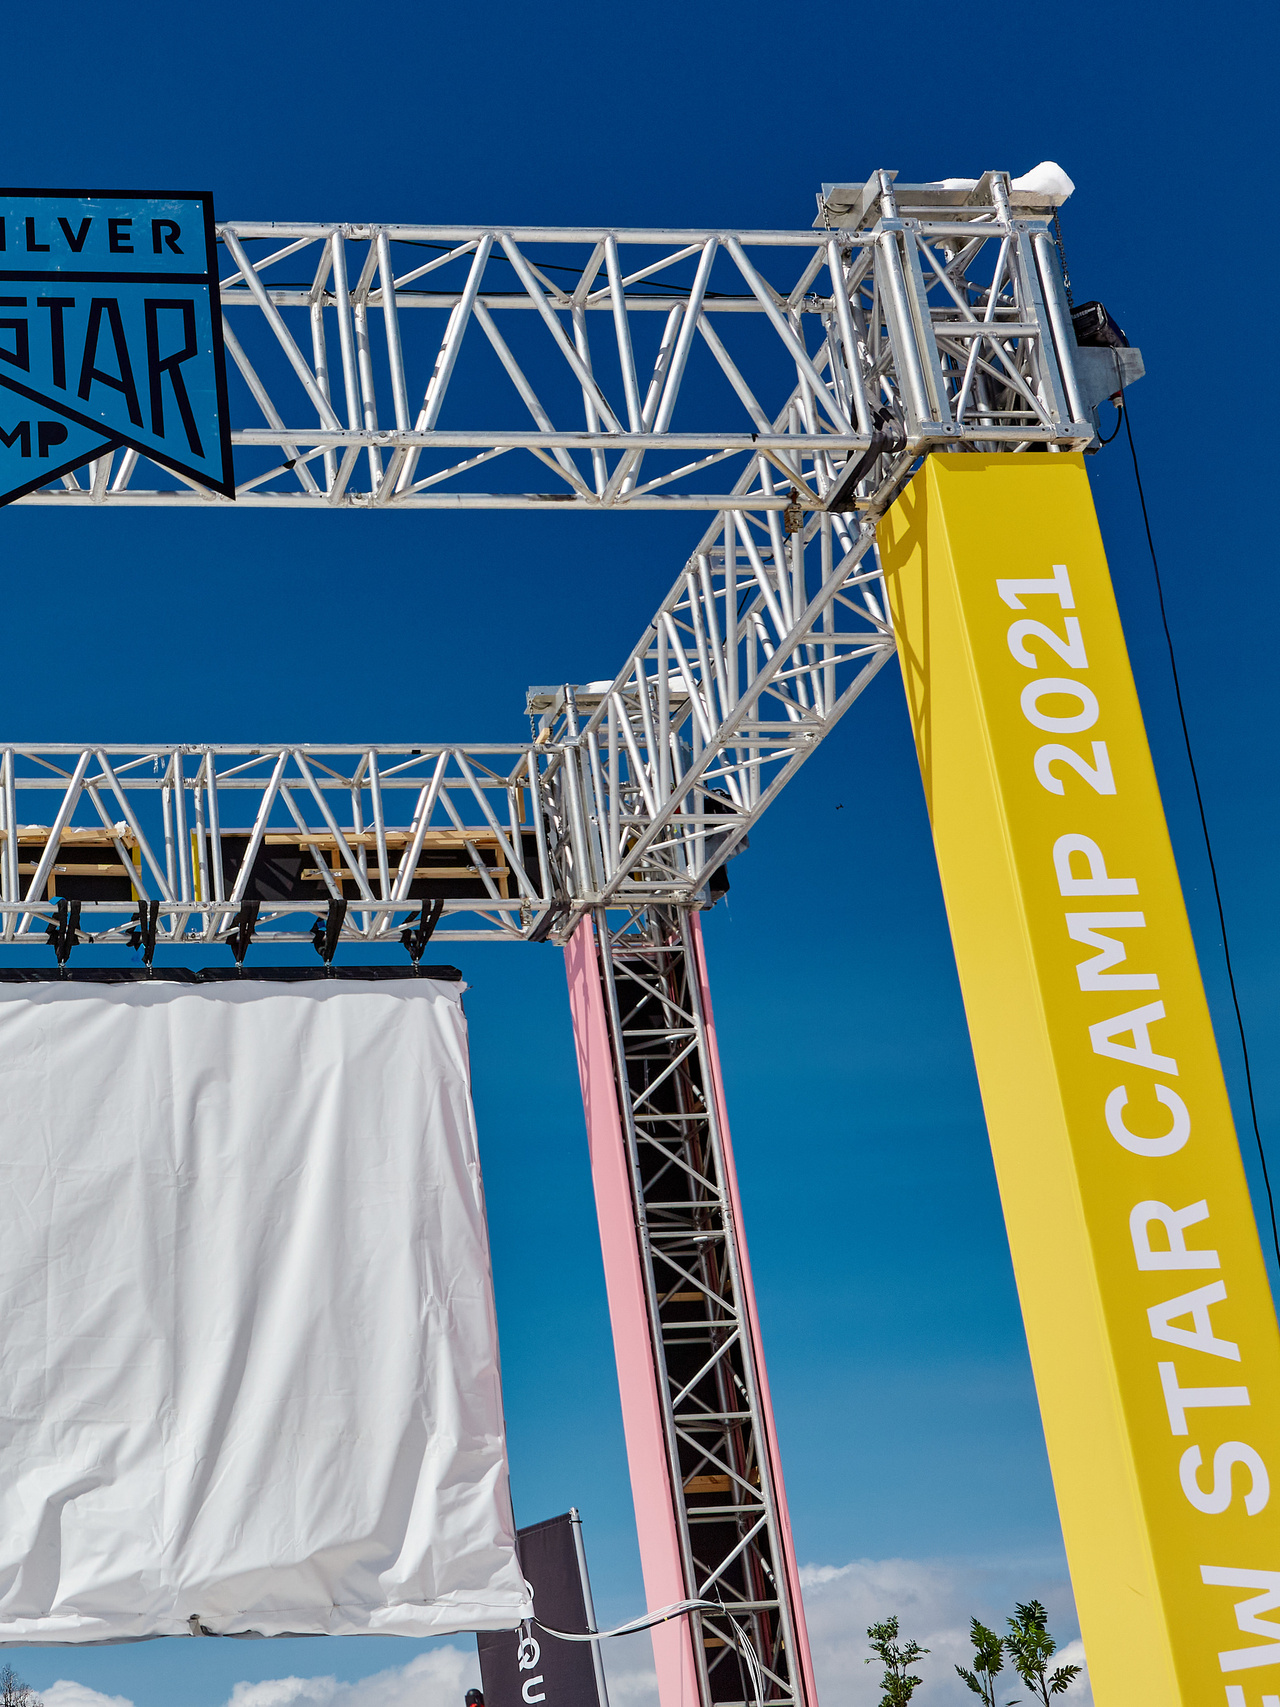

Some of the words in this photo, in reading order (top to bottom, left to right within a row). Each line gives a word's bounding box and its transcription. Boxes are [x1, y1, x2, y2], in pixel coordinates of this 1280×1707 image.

[996, 565, 1117, 796] 2021
[1053, 834, 1191, 1157] CAMP
[1130, 1200, 1270, 1516] STAR
